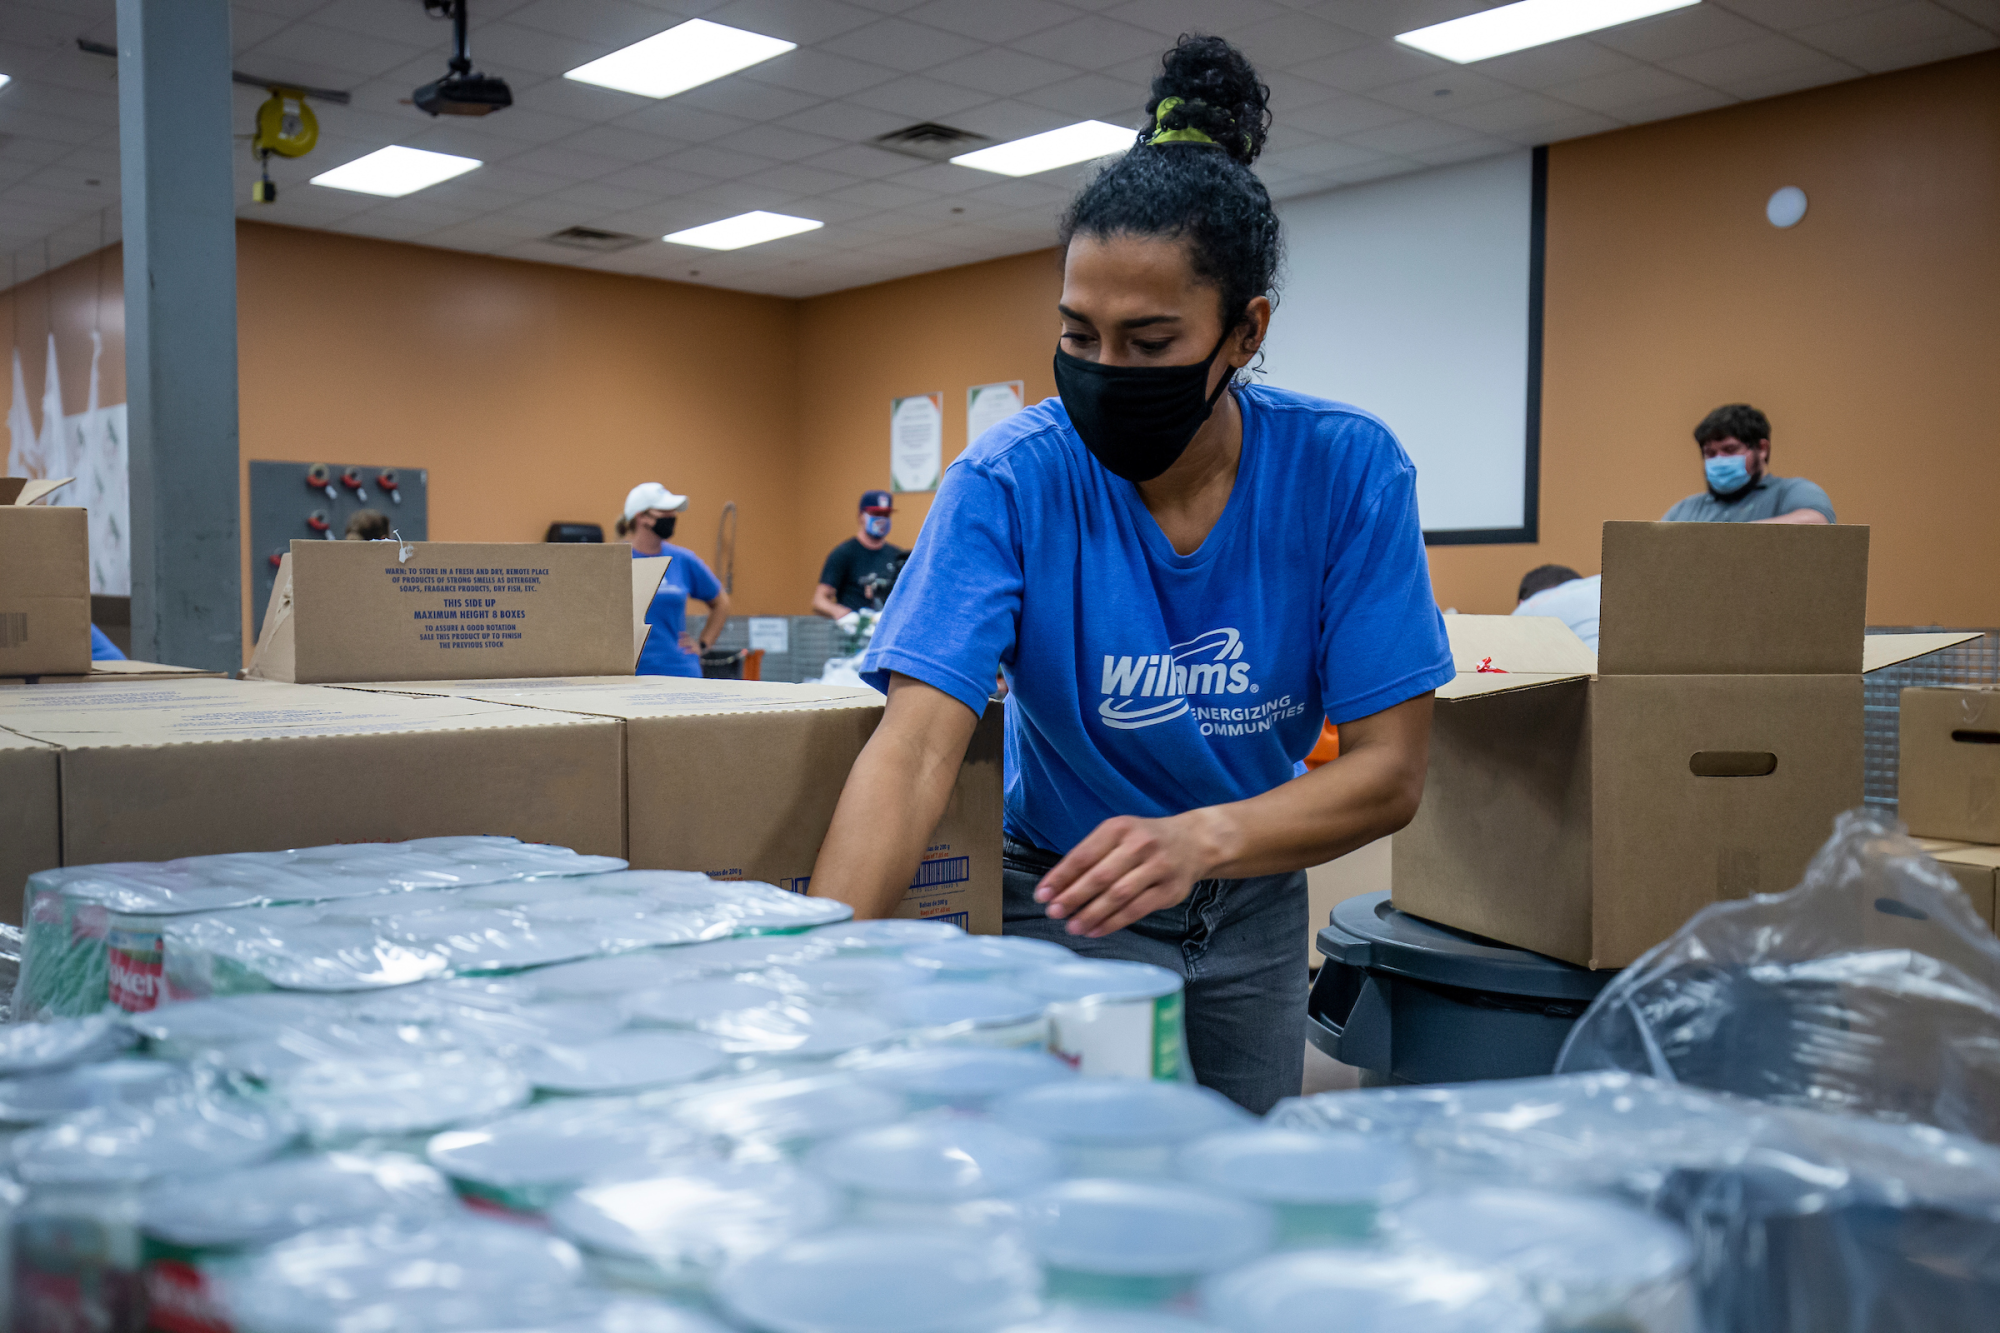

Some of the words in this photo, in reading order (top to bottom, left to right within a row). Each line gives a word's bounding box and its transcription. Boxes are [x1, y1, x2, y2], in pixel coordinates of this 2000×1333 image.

[491, 568, 504, 576] DRY,
[399, 585, 422, 593] SOAPS,
[458, 585, 492, 593] PRODUCTS,
[507, 585, 523, 593] FISH,
[444, 599, 462, 607] THIS
[464, 599, 482, 607] SIDE
[485, 599, 496, 607] UP
[414, 610, 457, 619] MAXIMUM
[460, 610, 489, 619] HEIGHT
[492, 610, 498, 619] 8
[500, 610, 526, 619] BOXES
[420, 632, 434, 640] SALE
[436, 632, 450, 640] THIS
[452, 632, 480, 640] PRODUCT
[482, 632, 490, 640] UP
[492, 632, 500, 640] TO
[502, 632, 522, 640] FINISH
[439, 641, 451, 649] THE
[452, 641, 483, 649] PREVIOUS
[485, 641, 504, 649] STOCK
[1200, 702, 1305, 737] OMMUNITIES
